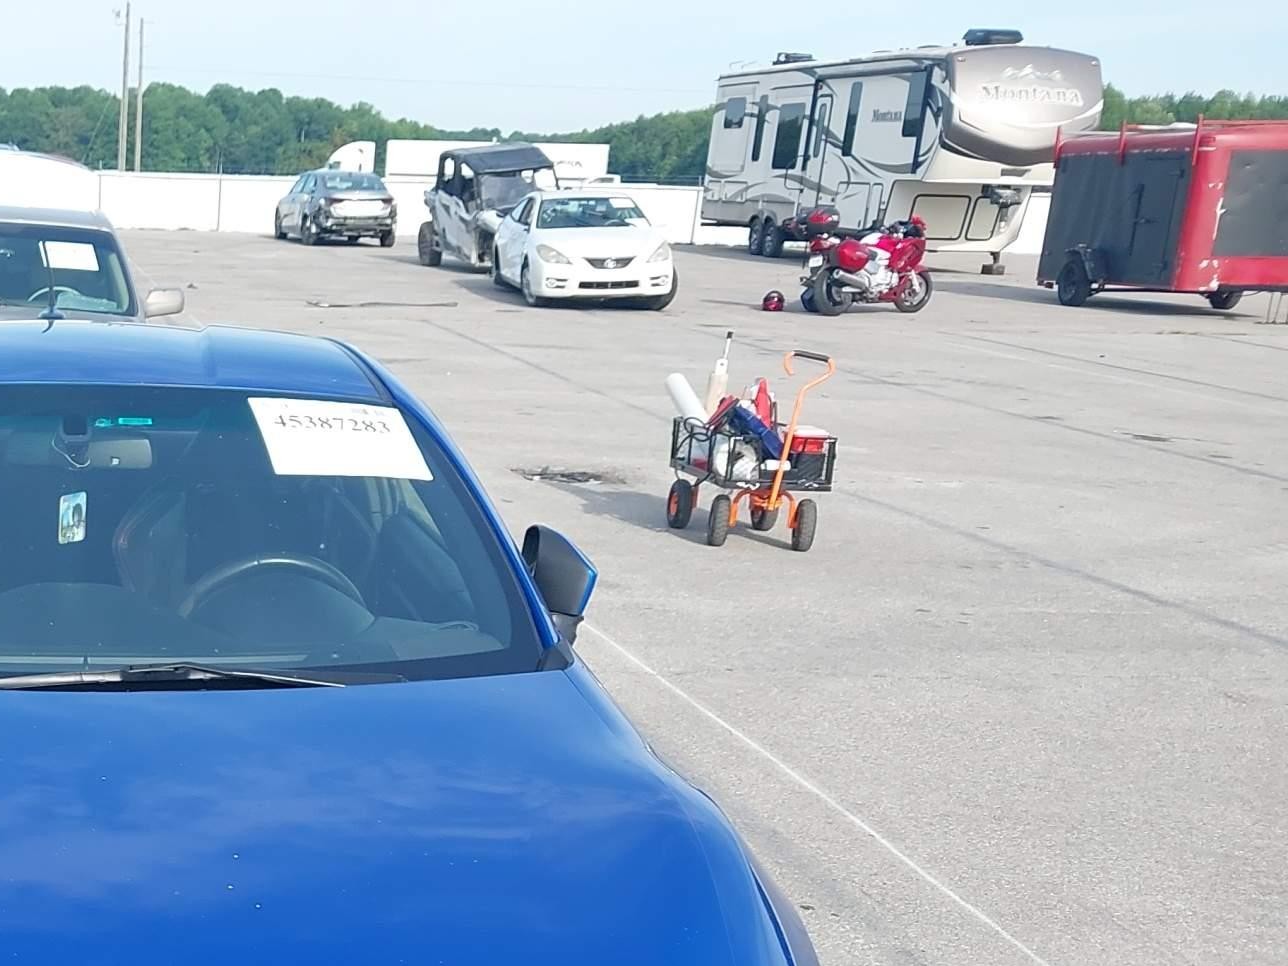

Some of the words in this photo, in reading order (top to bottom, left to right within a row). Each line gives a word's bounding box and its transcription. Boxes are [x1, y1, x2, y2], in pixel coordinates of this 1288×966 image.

[981, 84, 1083, 106] Montana
[871, 108, 902, 122] Montana
[274, 415, 391, 433] 45387283
